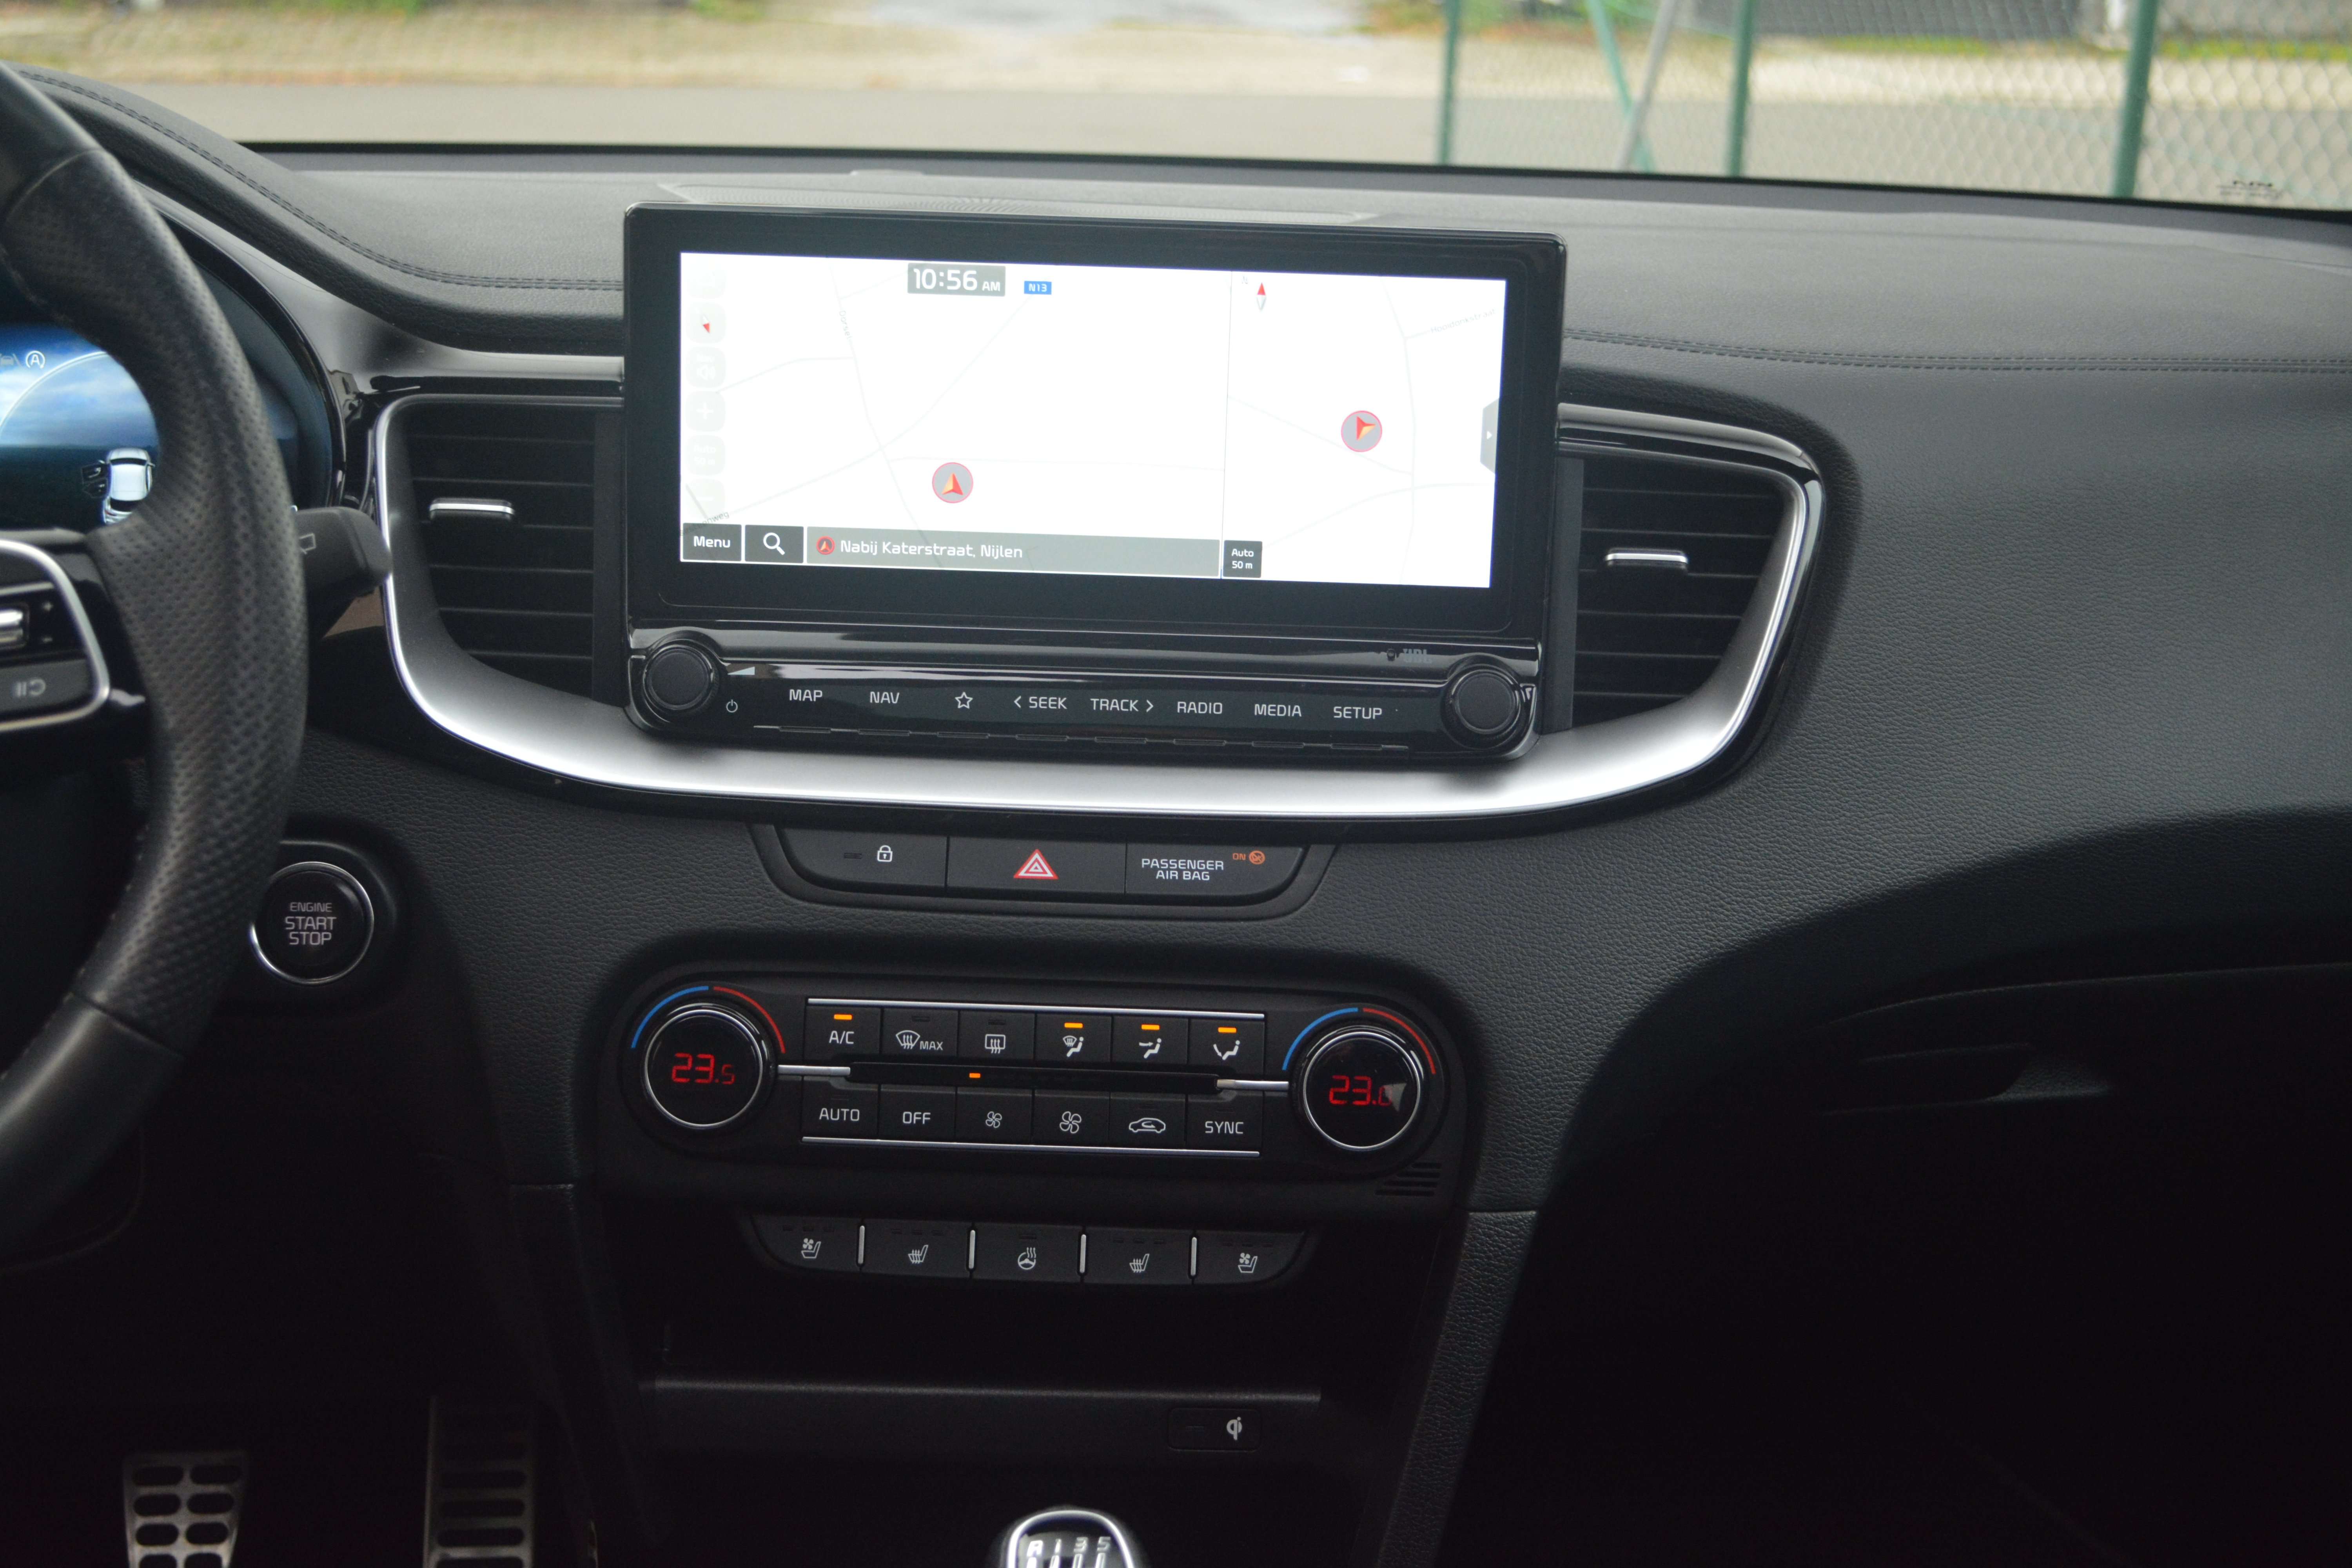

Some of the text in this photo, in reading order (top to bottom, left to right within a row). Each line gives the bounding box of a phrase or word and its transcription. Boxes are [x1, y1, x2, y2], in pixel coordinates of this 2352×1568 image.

[913, 269, 1000, 292] 10:56 AM
[1028, 283, 1047, 292] N13
[693, 536, 731, 548] Menu
[840, 540, 1023, 559] Nabij Katerstraat, Nijlen
[1231, 548, 1254, 558] Auto
[1231, 561, 1243, 569] 50
[789, 689, 823, 702] MAP
[869, 691, 900, 704] NAV
[1028, 696, 1068, 710] SEEK
[1090, 698, 1139, 712] TRACK
[1176, 701, 1223, 715] RADIO
[1254, 704, 1302, 717] MEDIA
[1333, 706, 1382, 720] SETUP
[1142, 858, 1224, 870] PASSENGER
[1156, 870, 1210, 881] AIR BAG
[289, 902, 332, 912] ENGINE
[285, 916, 337, 930] START
[289, 931, 332, 946] STOP
[829, 1030, 855, 1045] A/C
[920, 1040, 944, 1051] MAX
[671, 1052, 736, 1085] 23.5
[818, 1107, 860, 1122] AUTO
[902, 1111, 931, 1125] OFF
[1205, 1121, 1244, 1135] SYNC
[1073, 1537, 1089, 1553] 3
